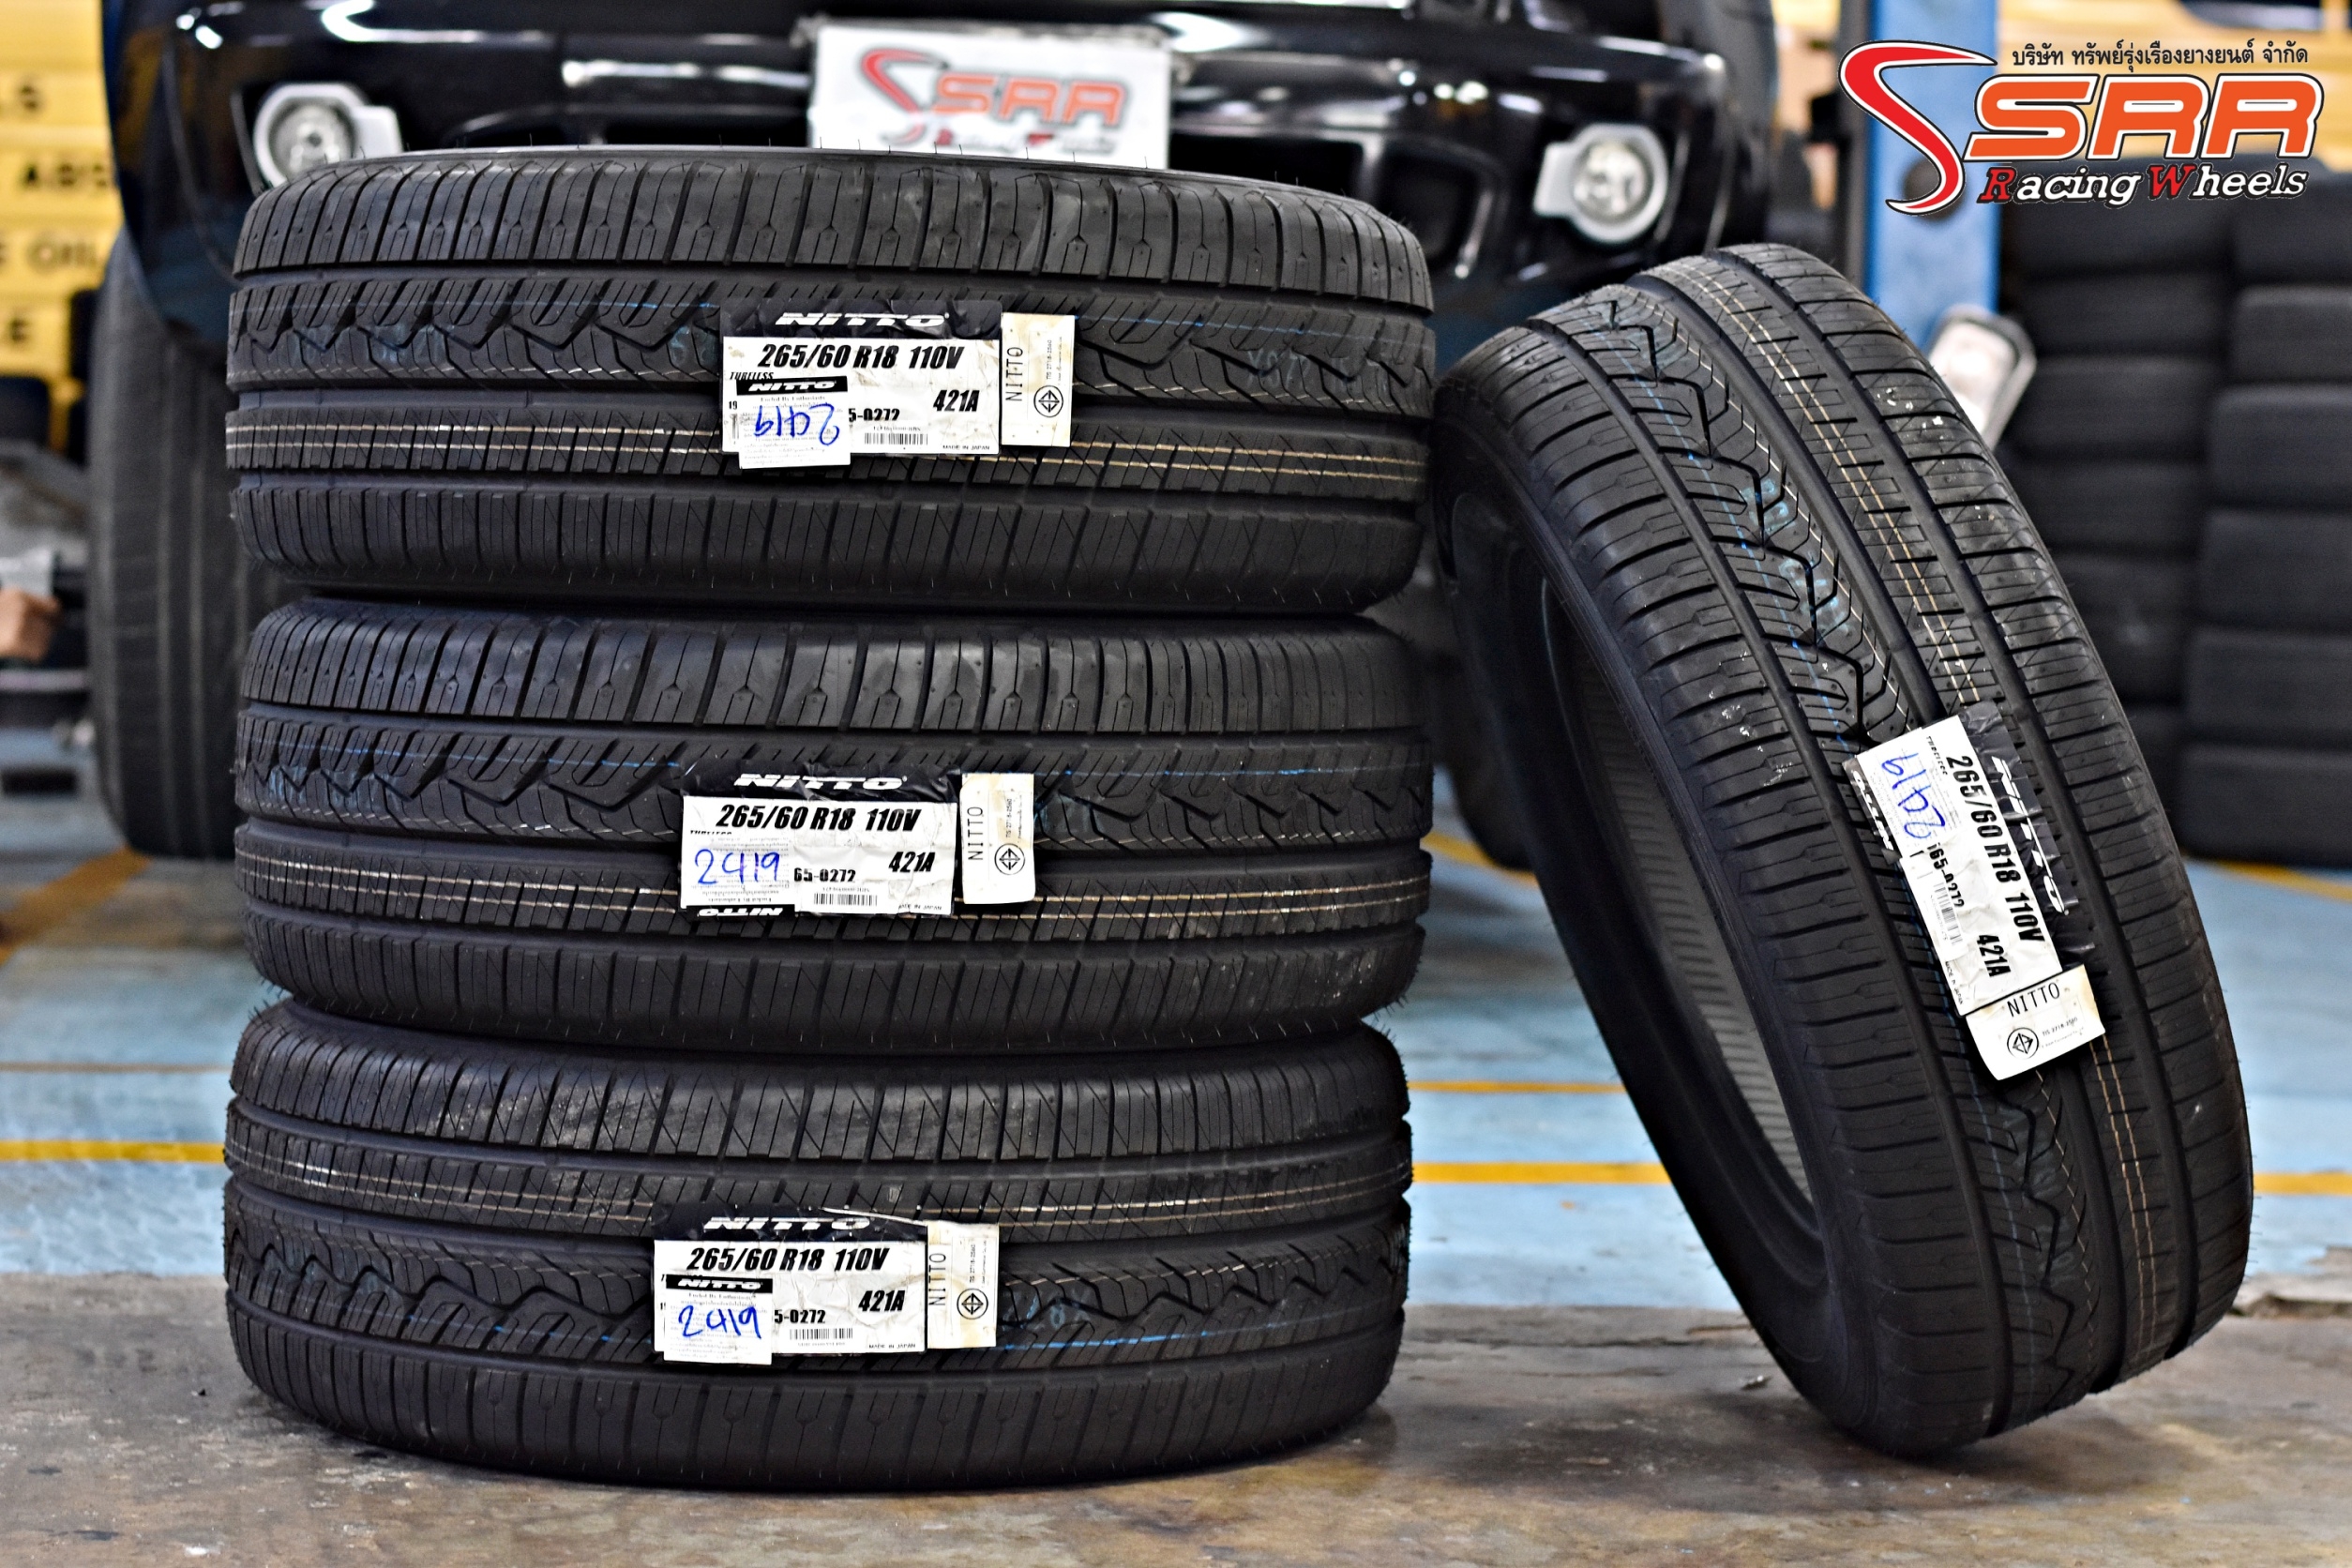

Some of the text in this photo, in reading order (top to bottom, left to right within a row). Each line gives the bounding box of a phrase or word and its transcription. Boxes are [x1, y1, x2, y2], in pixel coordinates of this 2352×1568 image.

[775, 312, 946, 327] NITTO
[758, 344, 965, 369] 265/60 R18 110V
[748, 380, 836, 392] NITTO
[1005, 347, 1023, 401] NITTO
[933, 389, 980, 413] 421A
[734, 774, 903, 791] NITTO
[716, 804, 922, 832] 265/60 R18 110V
[967, 807, 984, 860] NITTO
[1946, 755, 2003, 838] 265/60
[1984, 843, 2022, 883] R18
[2005, 892, 2045, 942] 110V
[889, 851, 936, 873] 421A
[793, 867, 856, 882] 65-0272
[698, 907, 783, 917] NITTO
[1977, 935, 2012, 977] 421A
[2007, 982, 2060, 1018] NITTO
[703, 1216, 870, 1230] NITTO
[686, 1248, 890, 1272] 265/60 R18 110V
[678, 1278, 761, 1289] NITTO
[928, 1253, 946, 1305] NITTO
[858, 1290, 906, 1313] 421A
[678, 1304, 761, 1339] 2419
